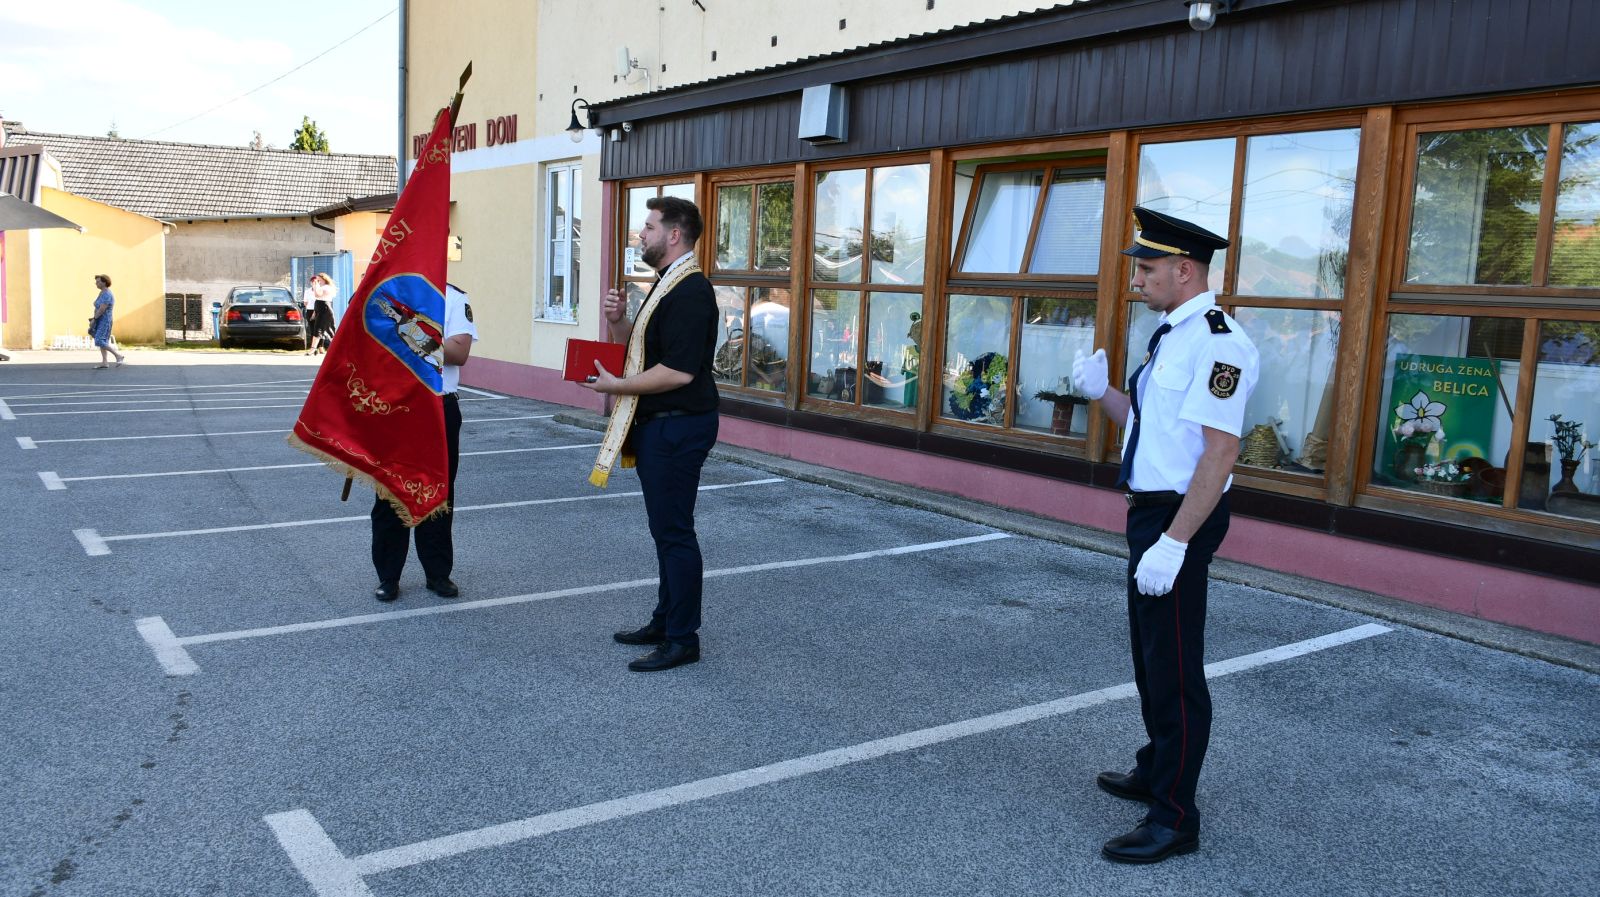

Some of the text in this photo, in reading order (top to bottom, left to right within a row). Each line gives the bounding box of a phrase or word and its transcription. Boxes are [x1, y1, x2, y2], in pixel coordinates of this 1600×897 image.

[413, 114, 517, 160] DRVENI DOM
[1221, 365, 1235, 373] DVD
[1400, 361, 1453, 374] UDRUGA
[1211, 386, 1230, 397] BELICA
[1433, 380, 1489, 397] BELICA
